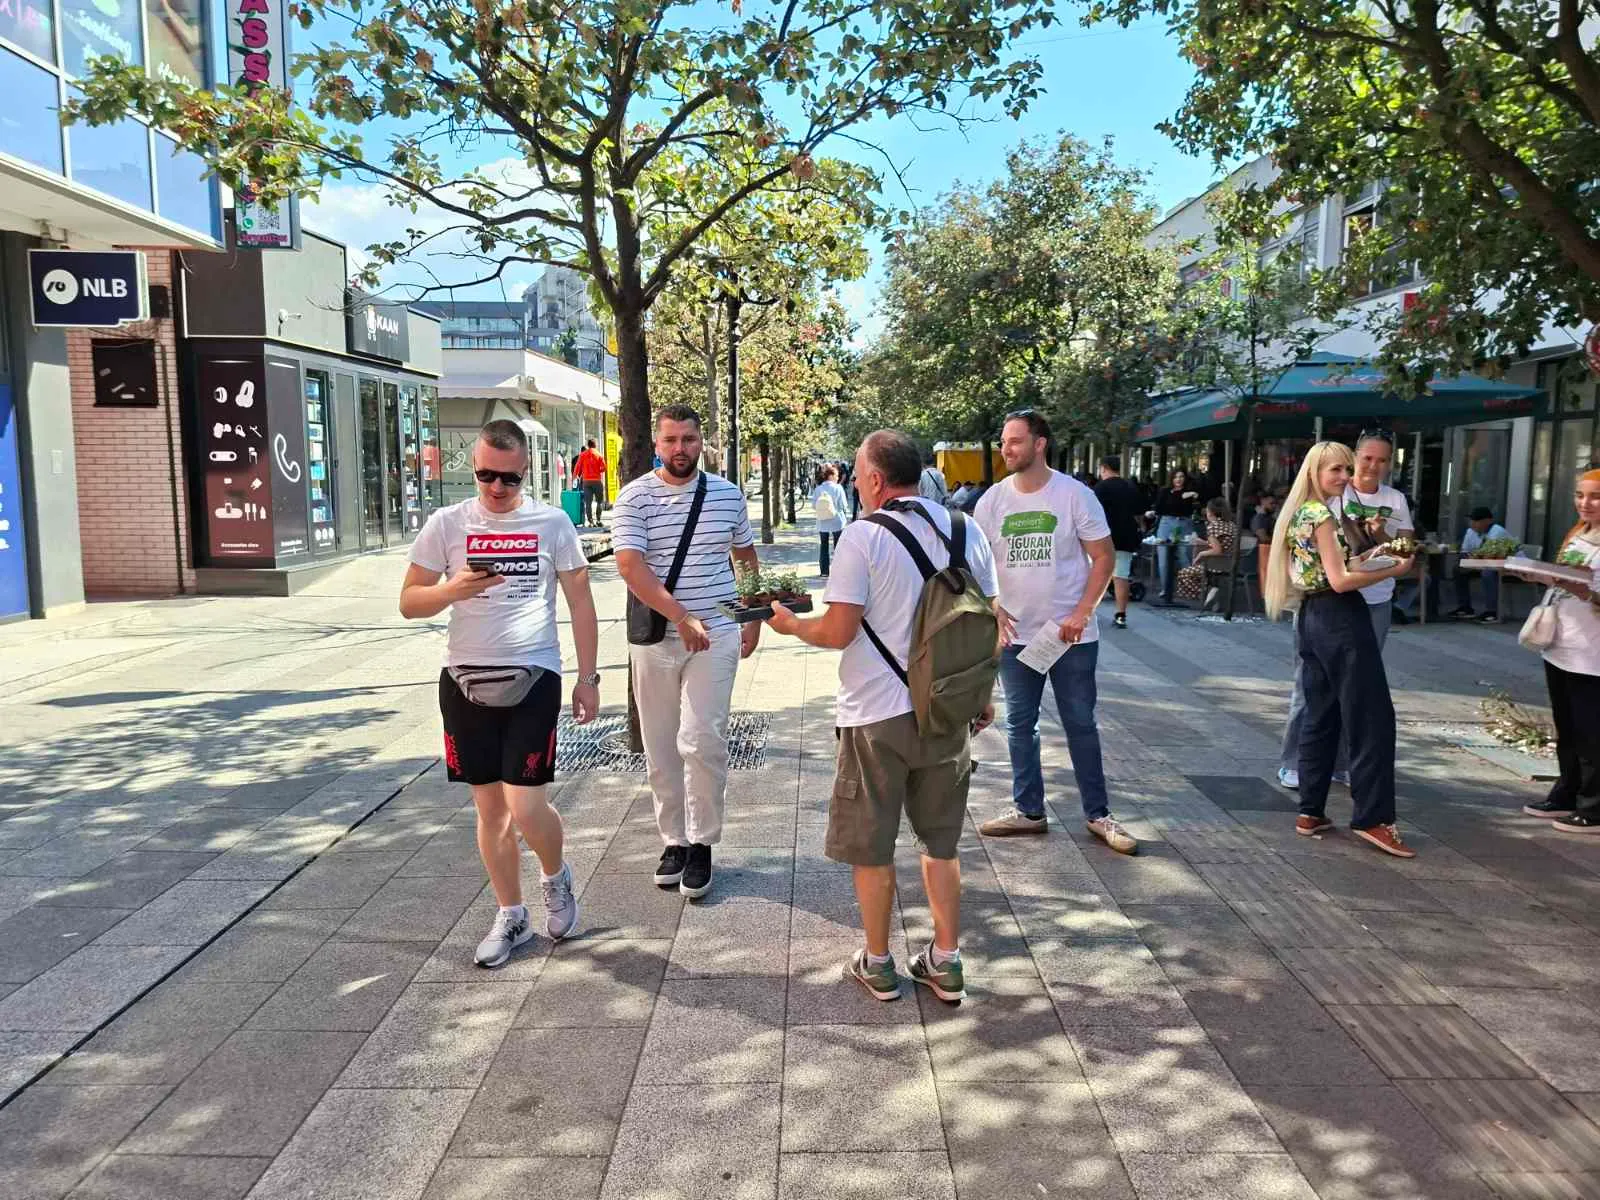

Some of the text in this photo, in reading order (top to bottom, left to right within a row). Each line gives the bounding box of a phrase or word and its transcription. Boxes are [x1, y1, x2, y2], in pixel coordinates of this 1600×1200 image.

[239, 0, 270, 84] ASS
[82, 278, 128, 298] NLB
[468, 537, 538, 550] kronos
[493, 561, 538, 572] onos
